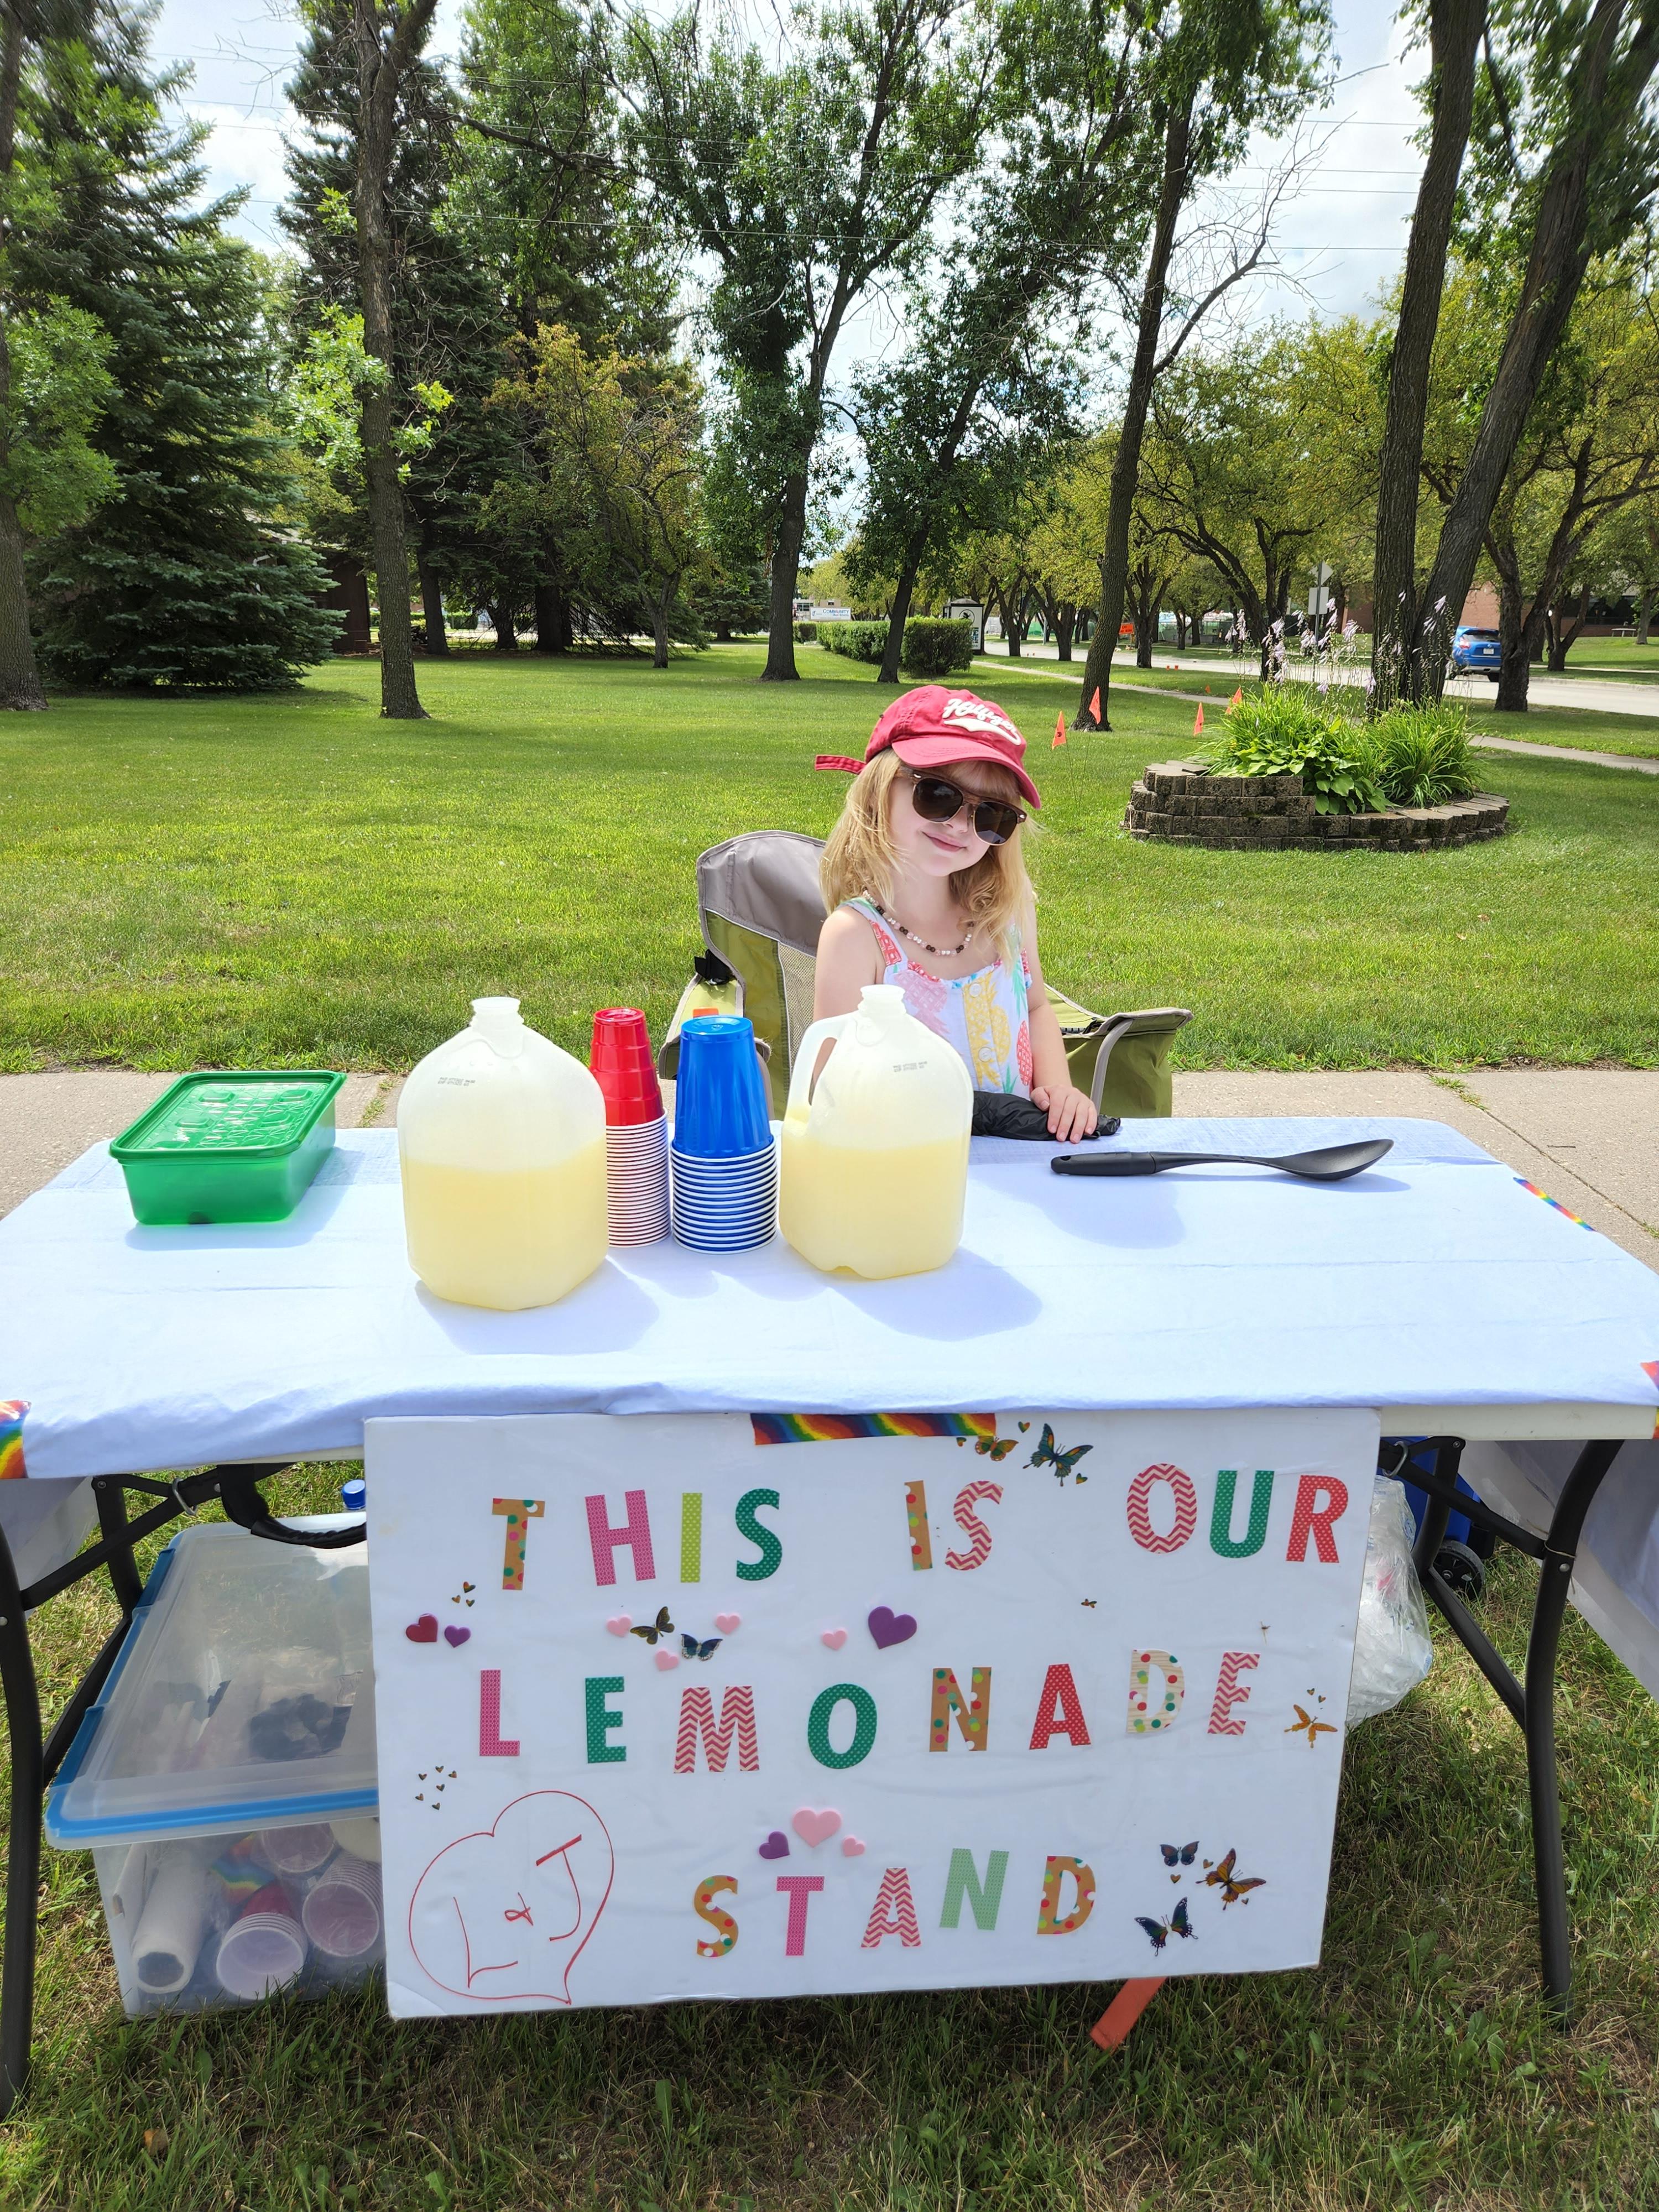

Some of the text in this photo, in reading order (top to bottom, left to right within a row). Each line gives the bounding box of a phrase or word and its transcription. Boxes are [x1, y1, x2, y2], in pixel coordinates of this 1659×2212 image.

[492, 1463, 1349, 1590] THIS IS OUR
[479, 1650, 1260, 1773] LEMONADE
[694, 1848, 1097, 1959] STAND
